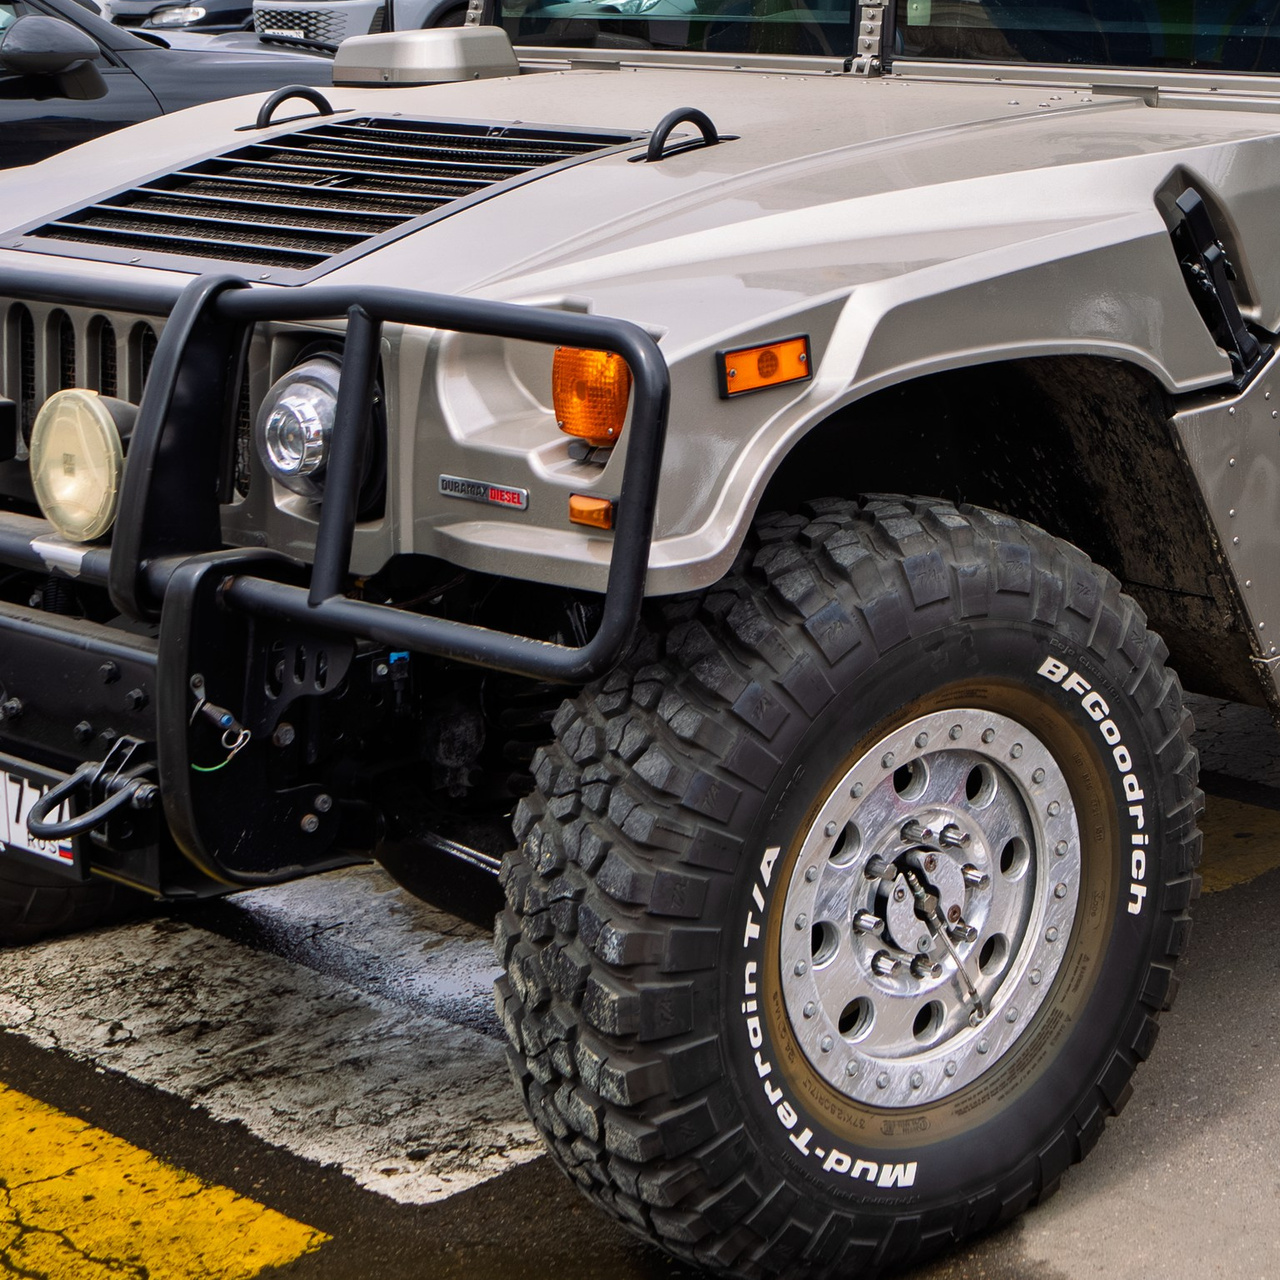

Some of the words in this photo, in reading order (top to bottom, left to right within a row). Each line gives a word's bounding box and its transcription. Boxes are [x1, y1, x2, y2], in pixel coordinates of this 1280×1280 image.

[489, 488, 523, 505] DIESEL
[1037, 656, 1149, 915] BFGoodrich
[743, 846, 781, 948] T/A
[741, 961, 918, 1188] Mud-Terrain
